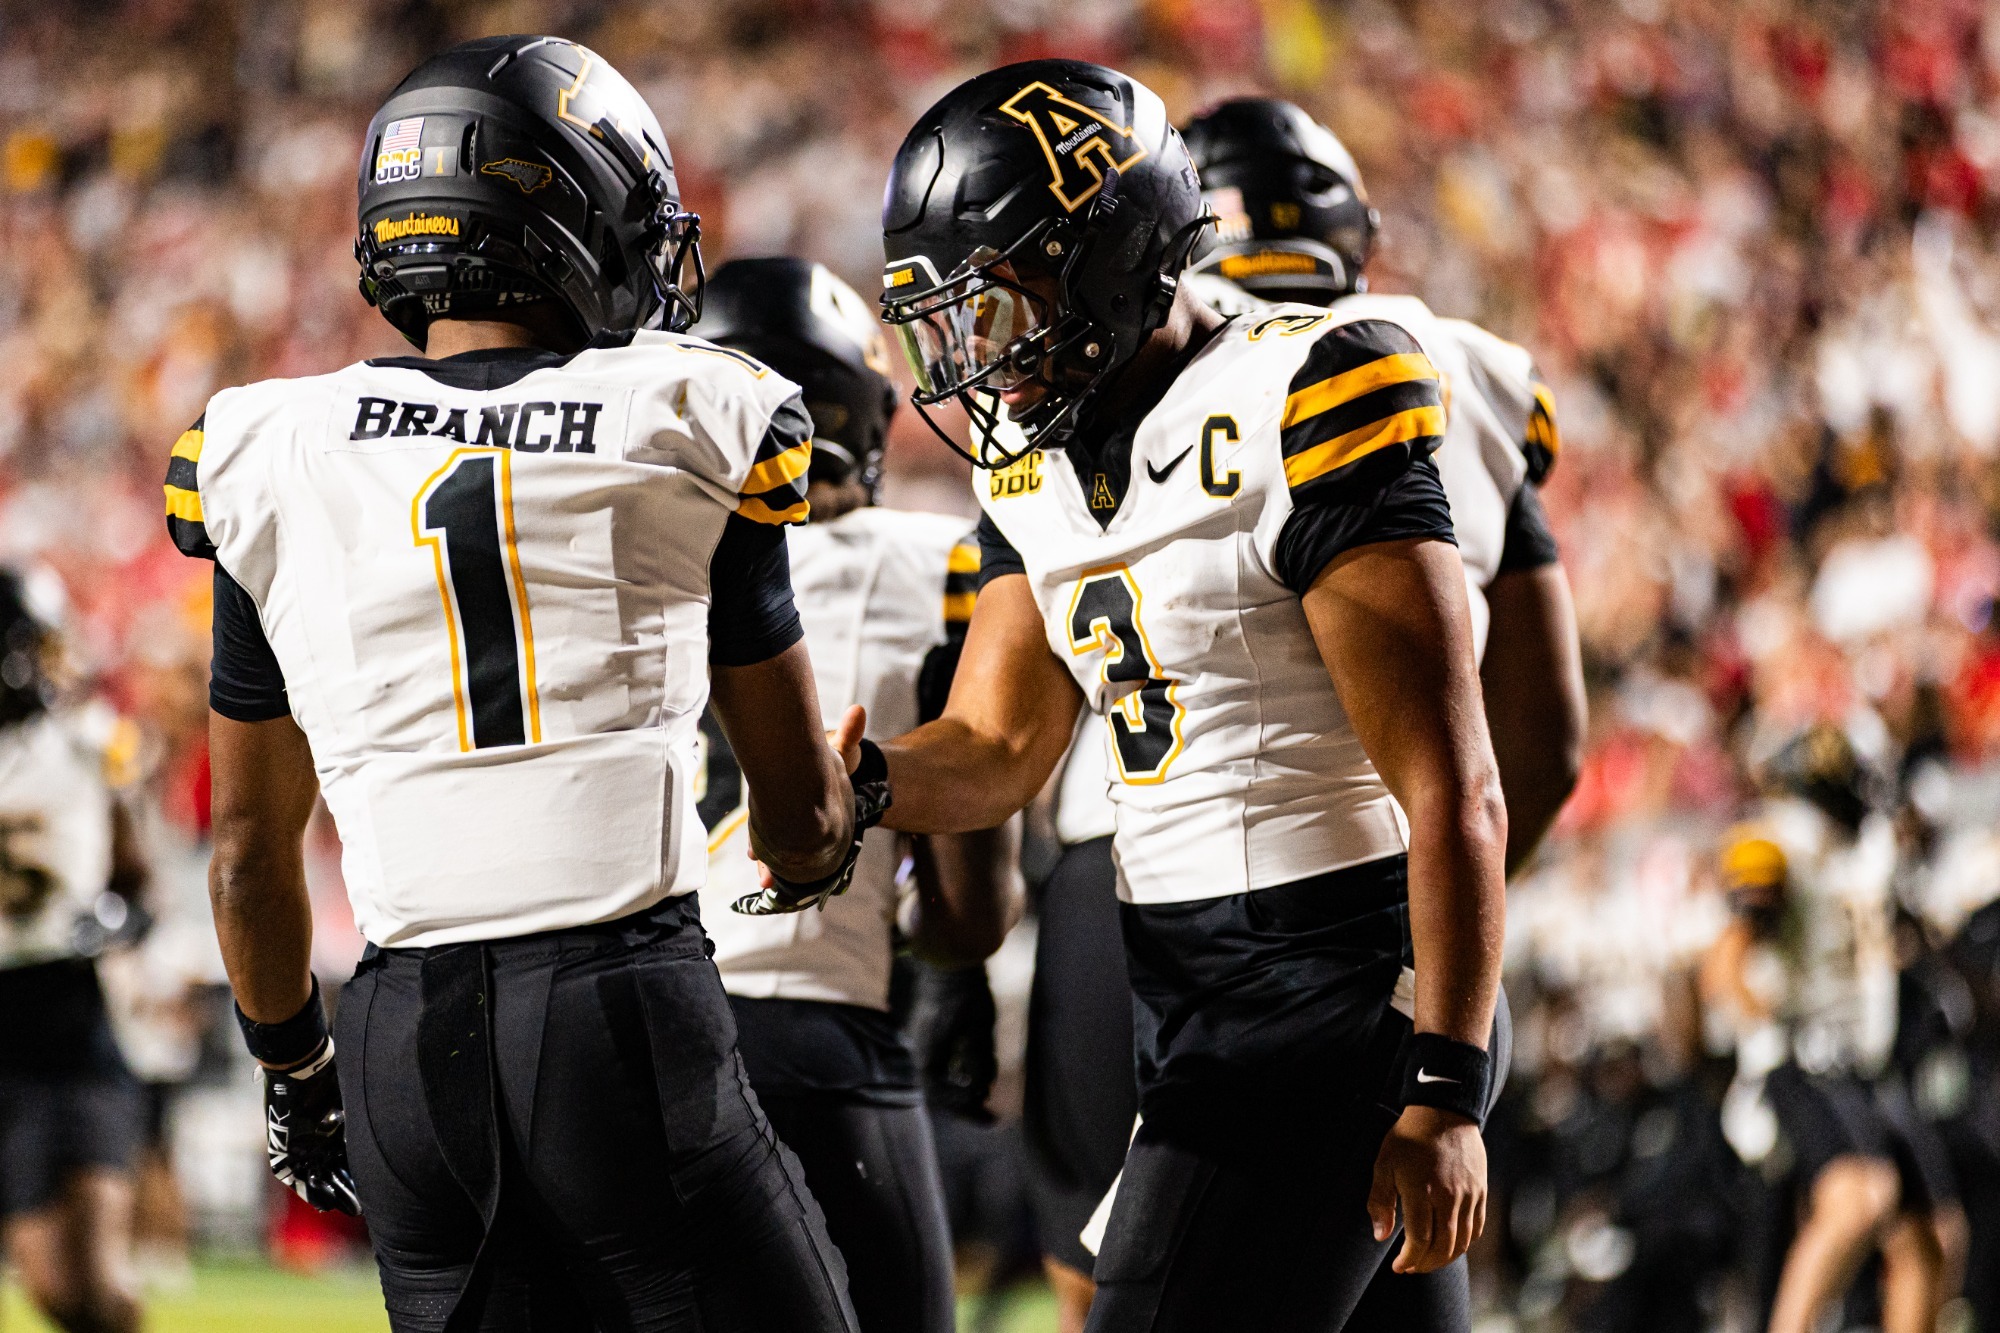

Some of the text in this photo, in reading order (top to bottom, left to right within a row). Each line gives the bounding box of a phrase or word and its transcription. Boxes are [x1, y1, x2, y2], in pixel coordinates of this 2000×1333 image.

[376, 148, 421, 185] SBC
[1000, 81, 1149, 213] A
[1055, 122, 1102, 155] Mountaineers
[374, 212, 460, 243] Mountaineers
[349, 396, 603, 454] BRANCH
[1200, 413, 1243, 499] C
[1092, 473, 1115, 509] A
[411, 448, 542, 753] 1
[1067, 562, 1186, 786] 3
